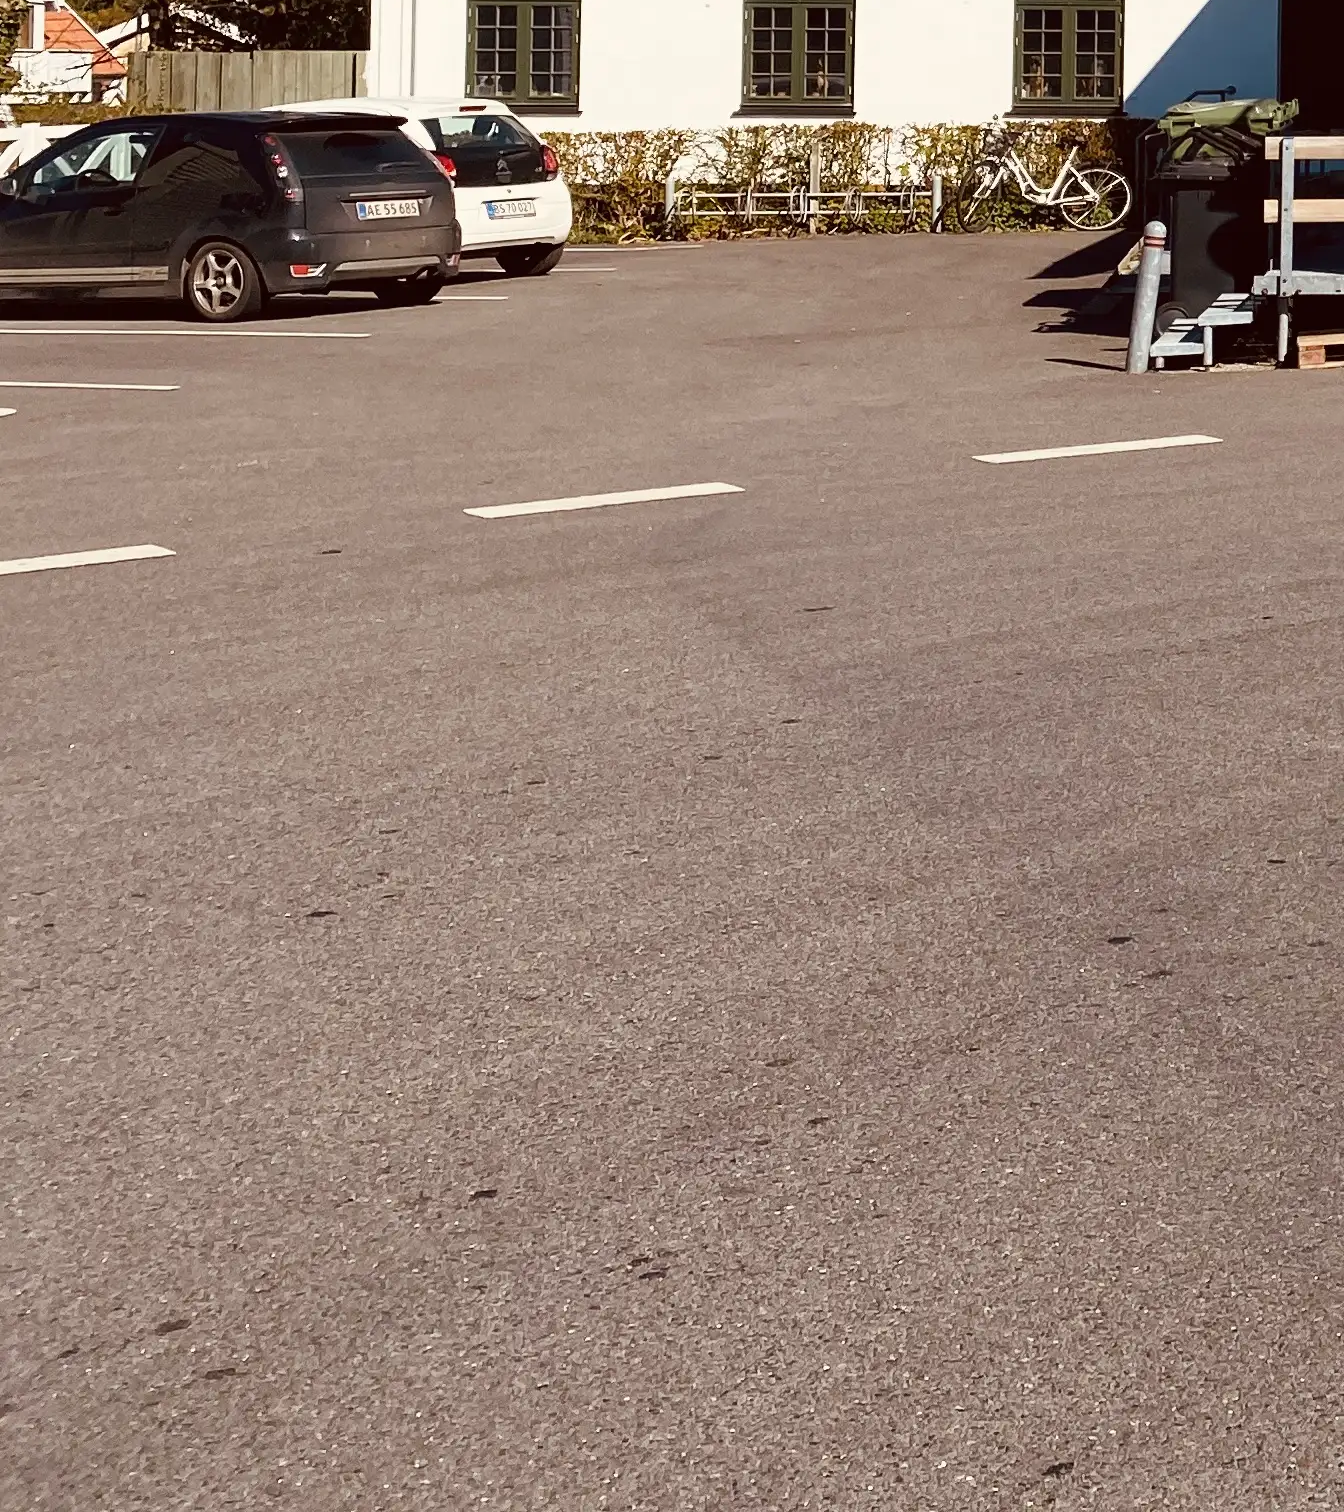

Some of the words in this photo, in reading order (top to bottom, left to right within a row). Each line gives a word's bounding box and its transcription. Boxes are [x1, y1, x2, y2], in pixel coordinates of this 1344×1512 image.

[367, 204, 381, 216] AE
[383, 203, 397, 215] 55
[399, 202, 417, 214] 685
[506, 203, 517, 213] 70
